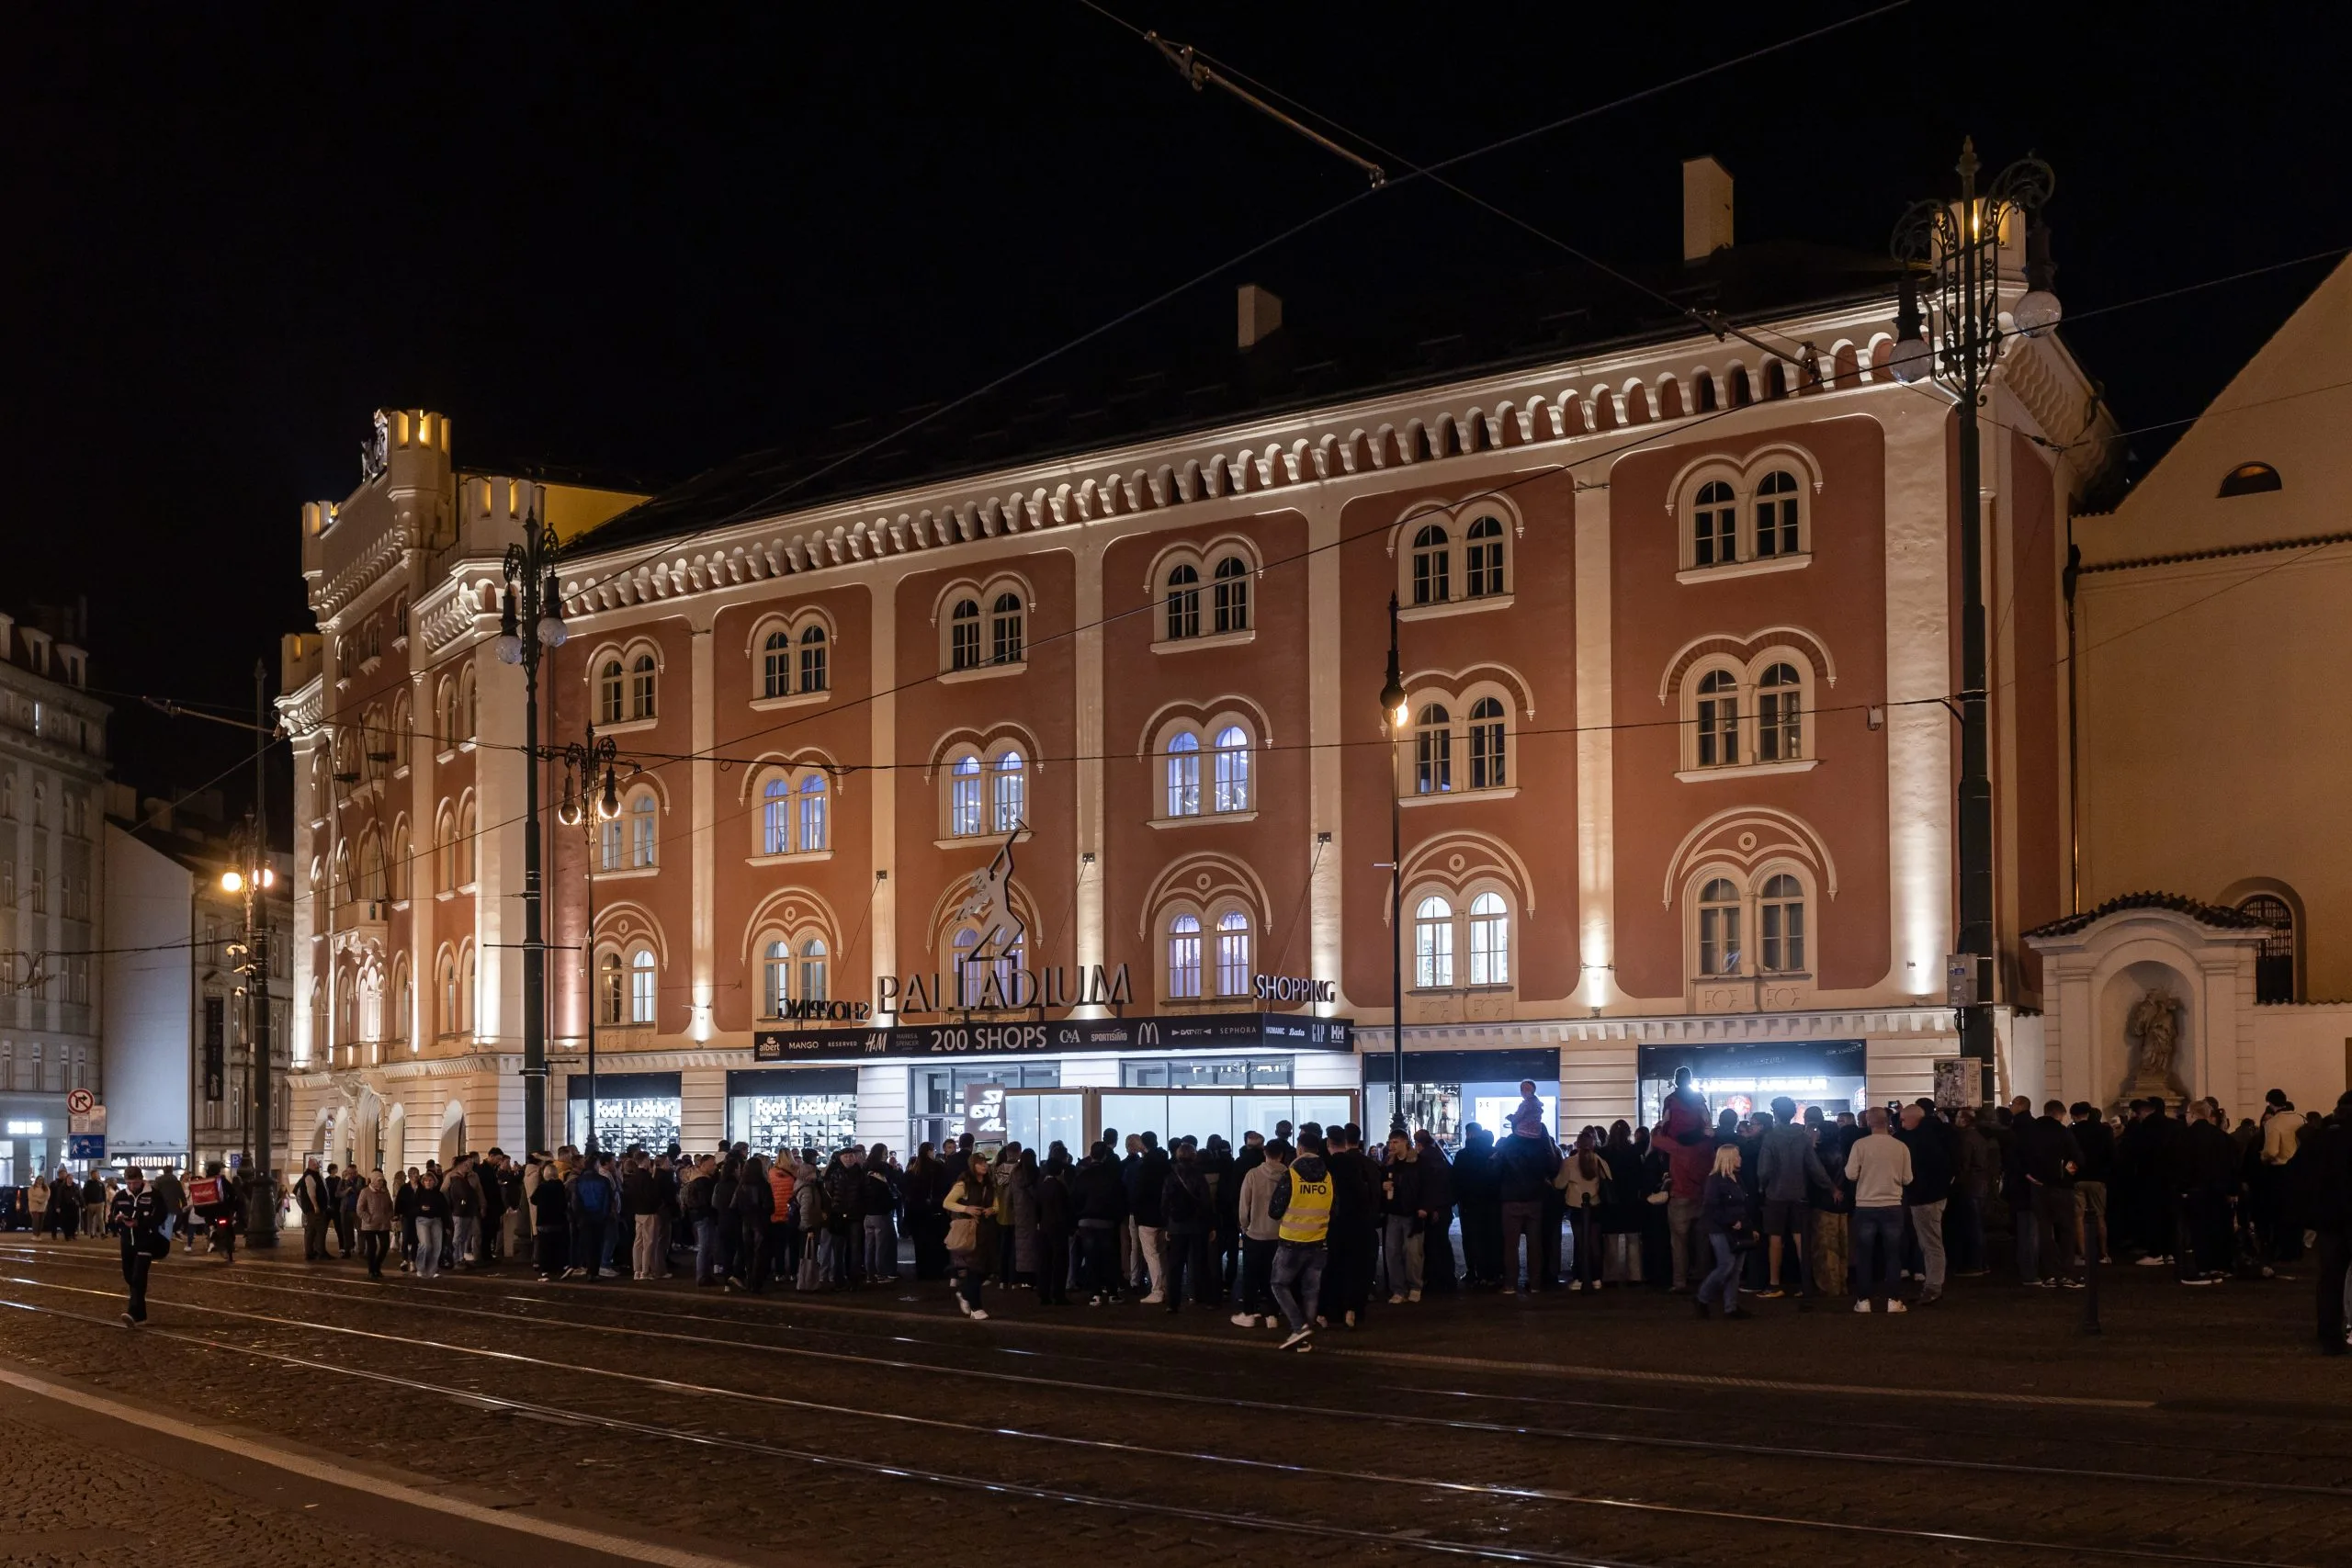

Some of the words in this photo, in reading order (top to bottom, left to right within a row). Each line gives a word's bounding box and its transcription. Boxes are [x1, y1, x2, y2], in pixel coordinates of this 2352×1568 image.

[877, 963, 1133, 1013] PALLADIUM
[1254, 974, 1336, 1003] SHOPPING
[1059, 1028, 1080, 1043] C&A
[1219, 1026, 1257, 1035] SEPHORA
[1288, 1027, 1306, 1037] Bata
[1312, 1023, 1325, 1043] GAP
[788, 1041, 820, 1050] MANGO
[865, 1032, 888, 1053] H&M
[931, 1029, 968, 1052] 200
[975, 1026, 1046, 1051] SHOPS
[759, 1043, 780, 1052] albert
[595, 1100, 624, 1118] Foot
[627, 1100, 673, 1118] Locker
[755, 1098, 787, 1116] Foot
[792, 1098, 842, 1115] Locker
[130, 1156, 176, 1168] RESTAURANT
[1300, 1184, 1327, 1195] INFO
